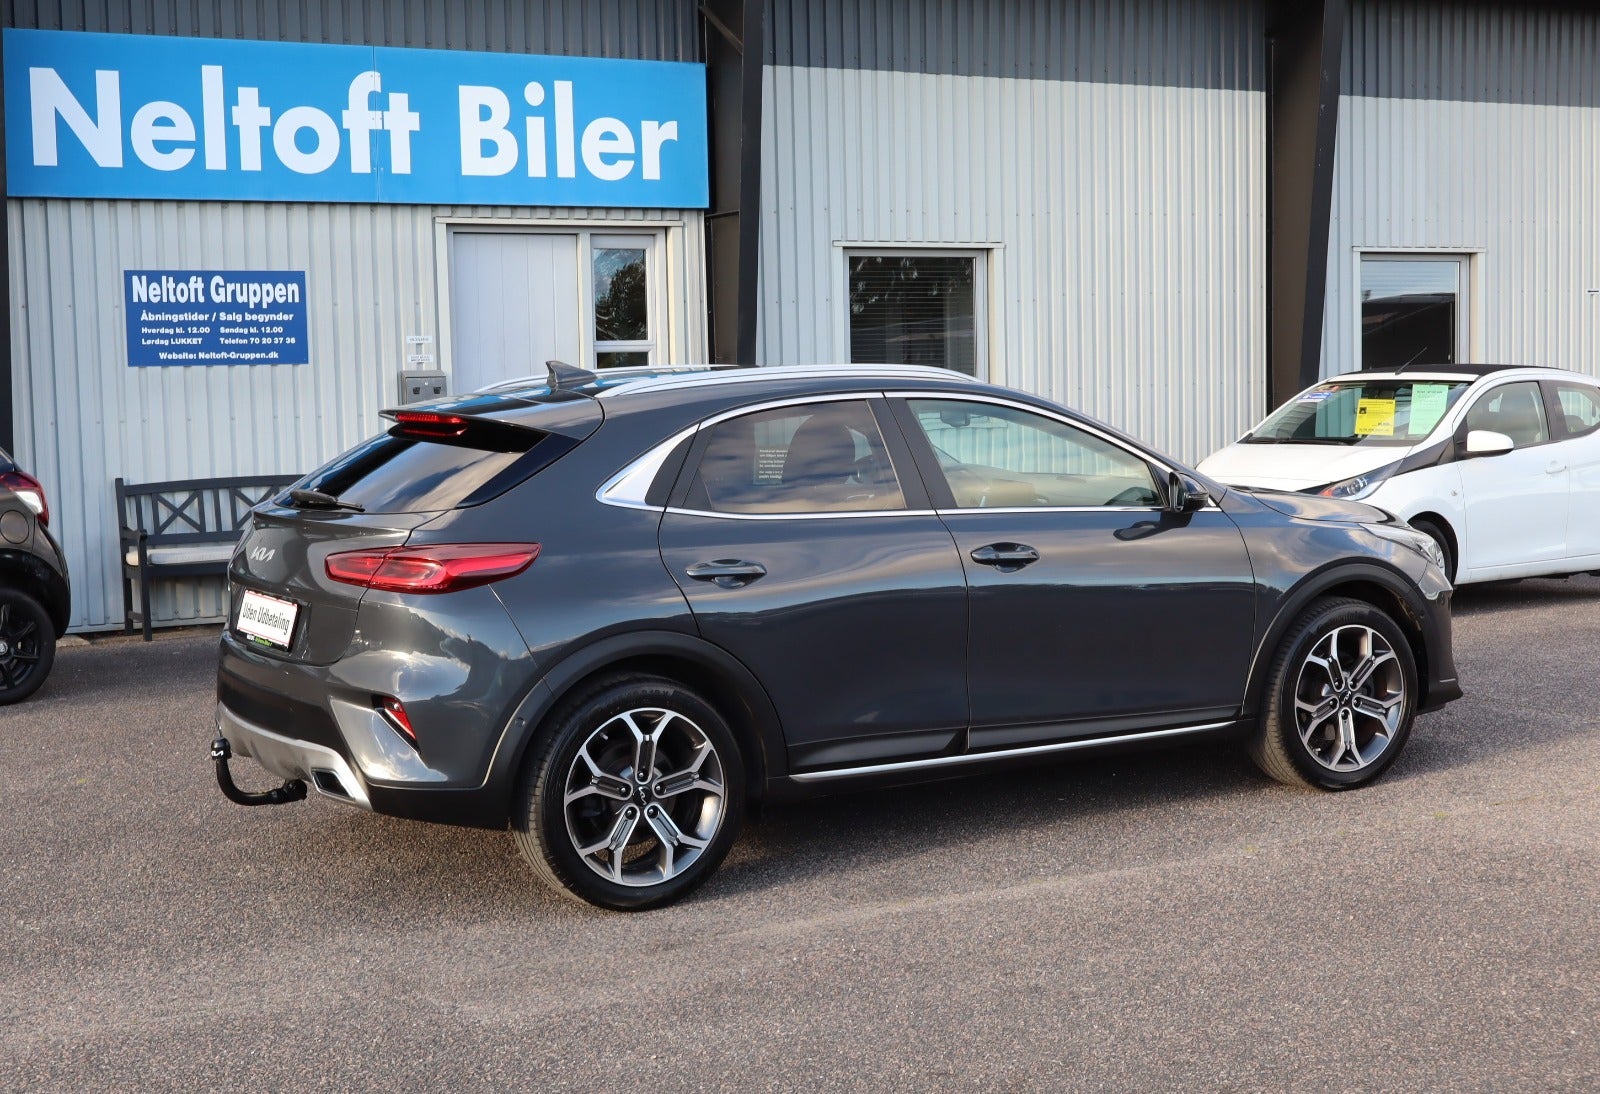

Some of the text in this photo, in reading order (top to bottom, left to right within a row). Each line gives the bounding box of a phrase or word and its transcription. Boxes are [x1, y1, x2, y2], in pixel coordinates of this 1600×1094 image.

[29, 65, 678, 182] Neltoft Biler
[131, 275, 301, 309] Neltoft Gruppen
[140, 309, 294, 323] Åbningstider / Salg begynder
[141, 327, 175, 335] Hverdag
[187, 326, 211, 334] 12.00
[219, 326, 249, 335] Søndag
[261, 326, 284, 334] 12.00
[141, 337, 203, 346] Lørdag LUKKET
[219, 337, 248, 345] Telefon
[158, 351, 279, 360] Website: Neltoft-Gruppen.dk
[242, 601, 291, 636] Uden Udbetaling
